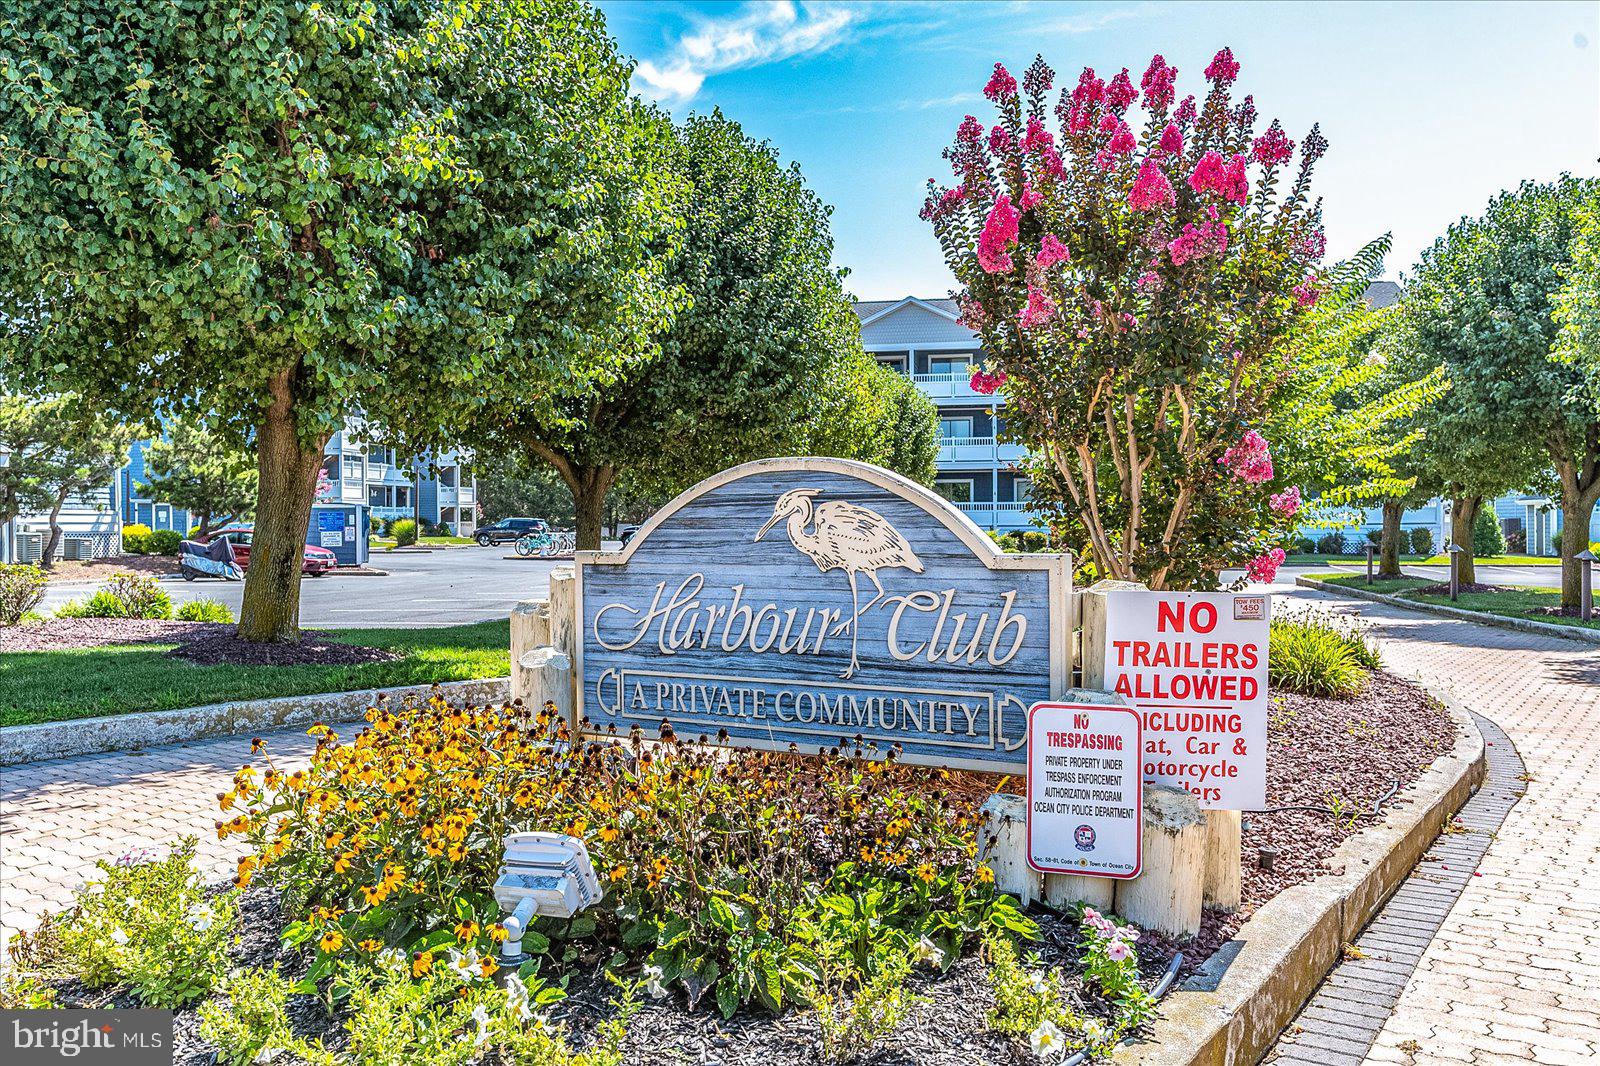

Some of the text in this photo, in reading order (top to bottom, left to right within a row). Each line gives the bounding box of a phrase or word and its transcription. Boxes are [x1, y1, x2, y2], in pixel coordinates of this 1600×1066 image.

[593, 572, 1028, 667] Harbour Club
[1157, 601, 1218, 634] NO
[1113, 640, 1259, 670] TRAILERS
[1114, 673, 1259, 701] ALLOWED
[630, 680, 982, 737] A PRIVATE COMMUNITY
[1073, 714, 1089, 730] NO
[1143, 712, 1242, 733] CLUDING
[1046, 731, 1123, 751] TRESPASSING
[1145, 736, 1248, 757] at, Car &
[1045, 755, 1123, 770] PRIVATE PROPERTY UNDER
[1144, 759, 1239, 783] otorcycle
[1046, 771, 1122, 786] TRESPASS ENFORCEMENT
[1044, 787, 1122, 802] AUTHORIZATION PROGRAM
[1034, 801, 1135, 819] OCEAN CITY POLICE DEPARTMENT
